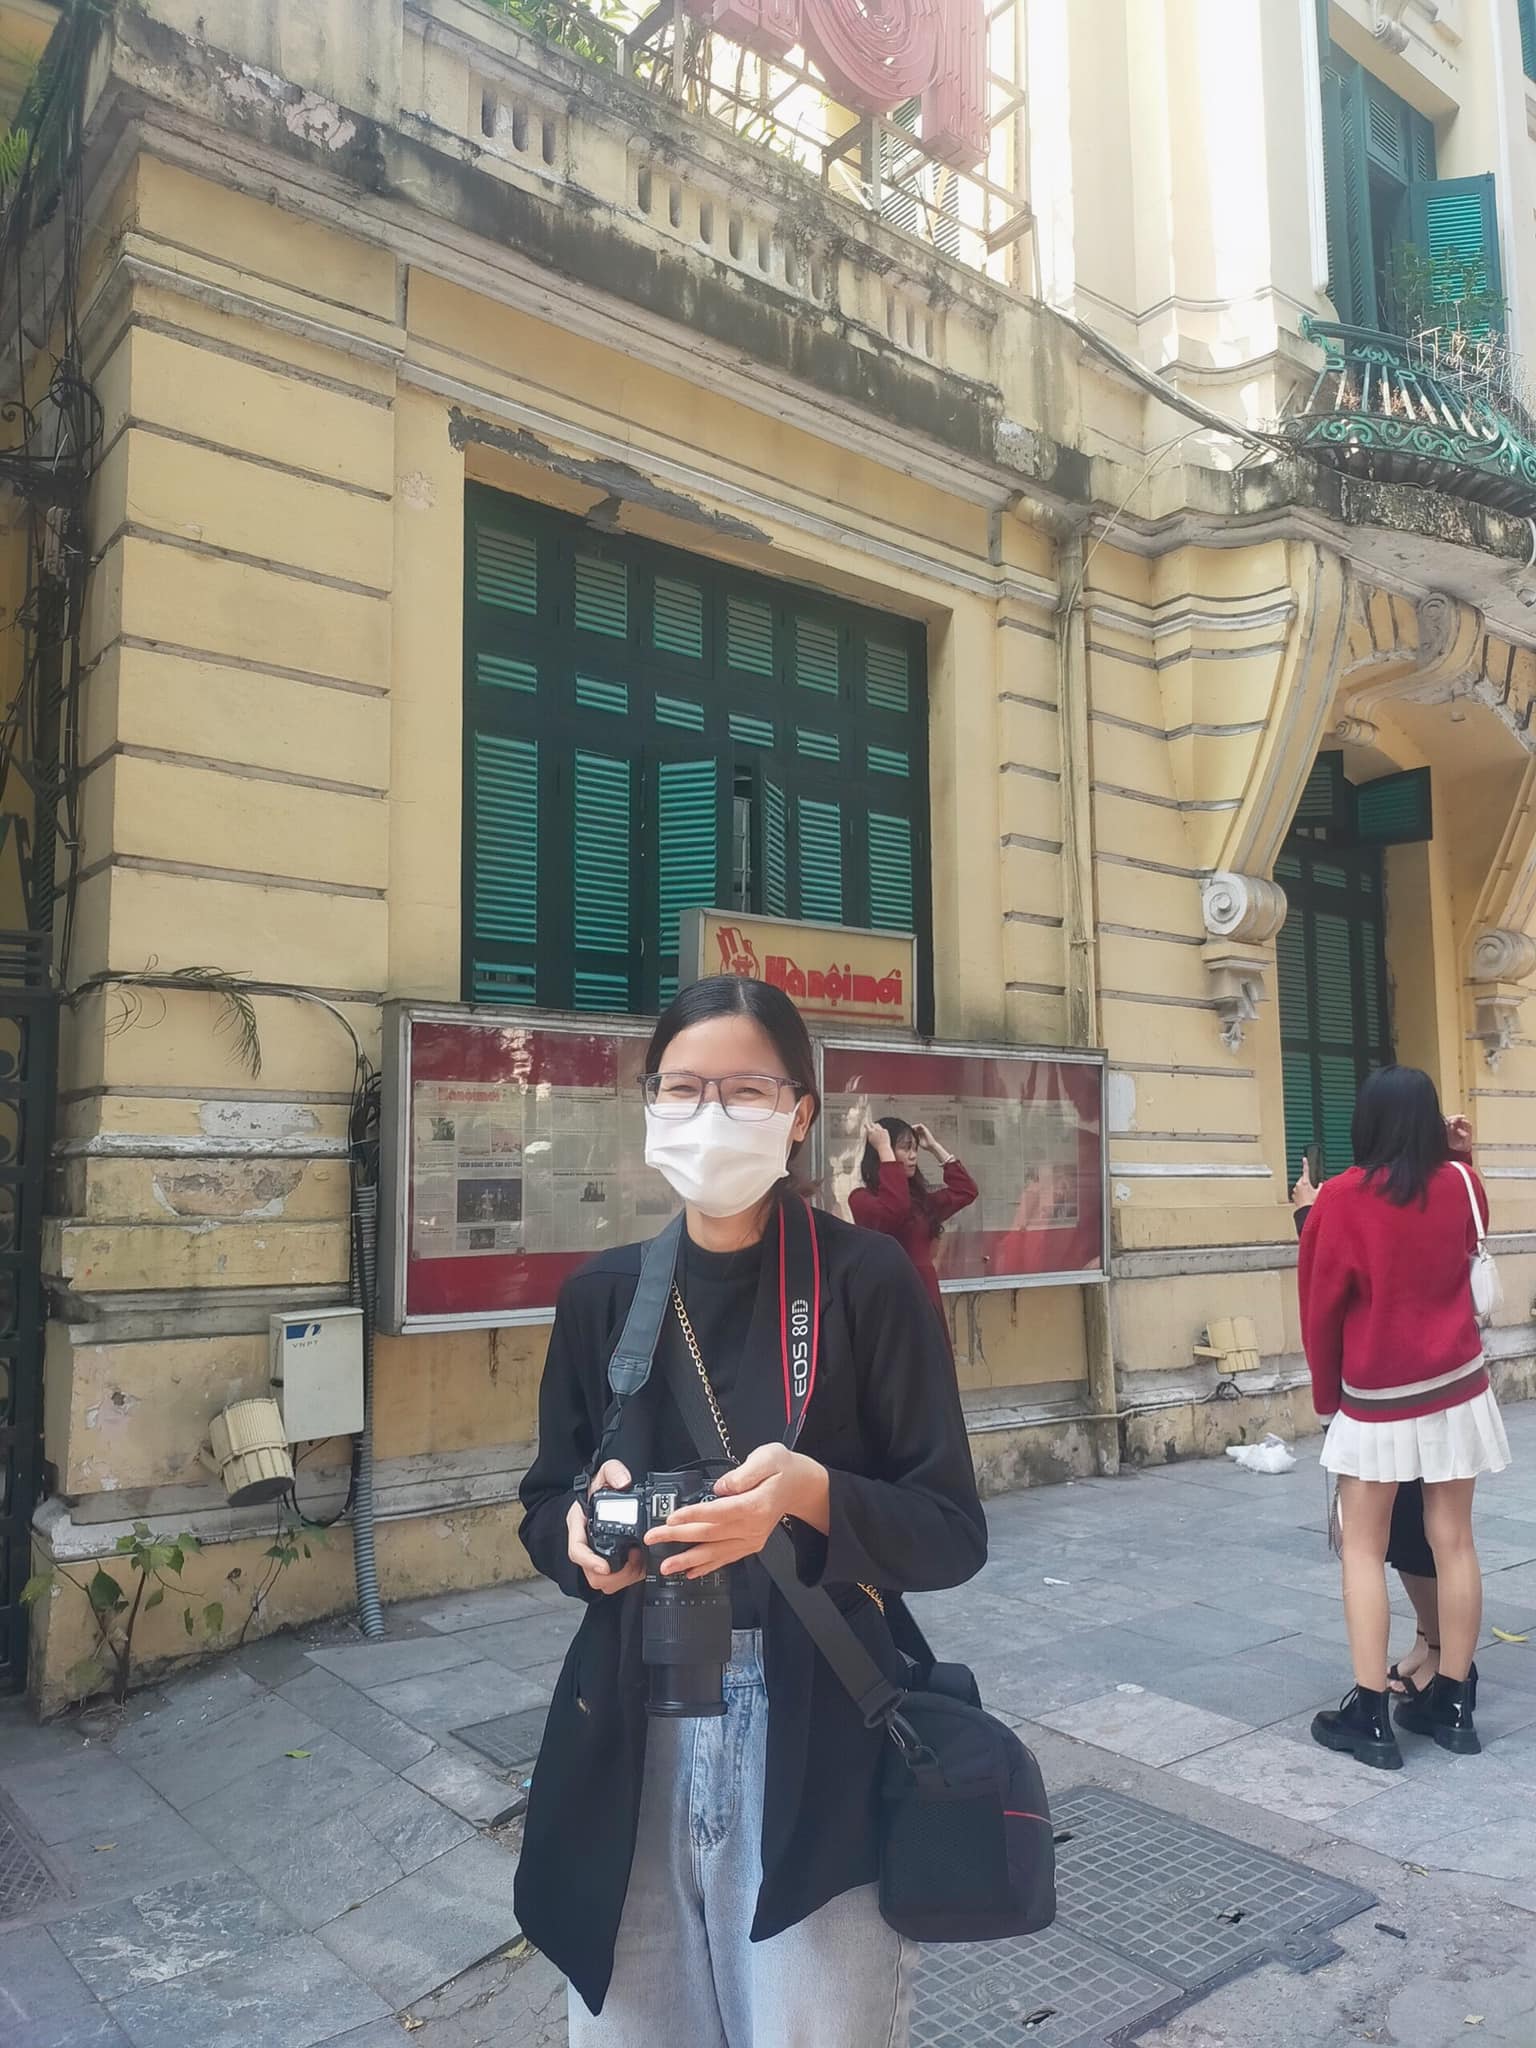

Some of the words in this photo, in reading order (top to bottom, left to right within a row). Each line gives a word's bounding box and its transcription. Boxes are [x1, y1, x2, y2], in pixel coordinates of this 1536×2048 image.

[791, 1299, 808, 1337] 80D
[292, 1340, 319, 1349] VNPT
[793, 1342, 808, 1397] EOS
